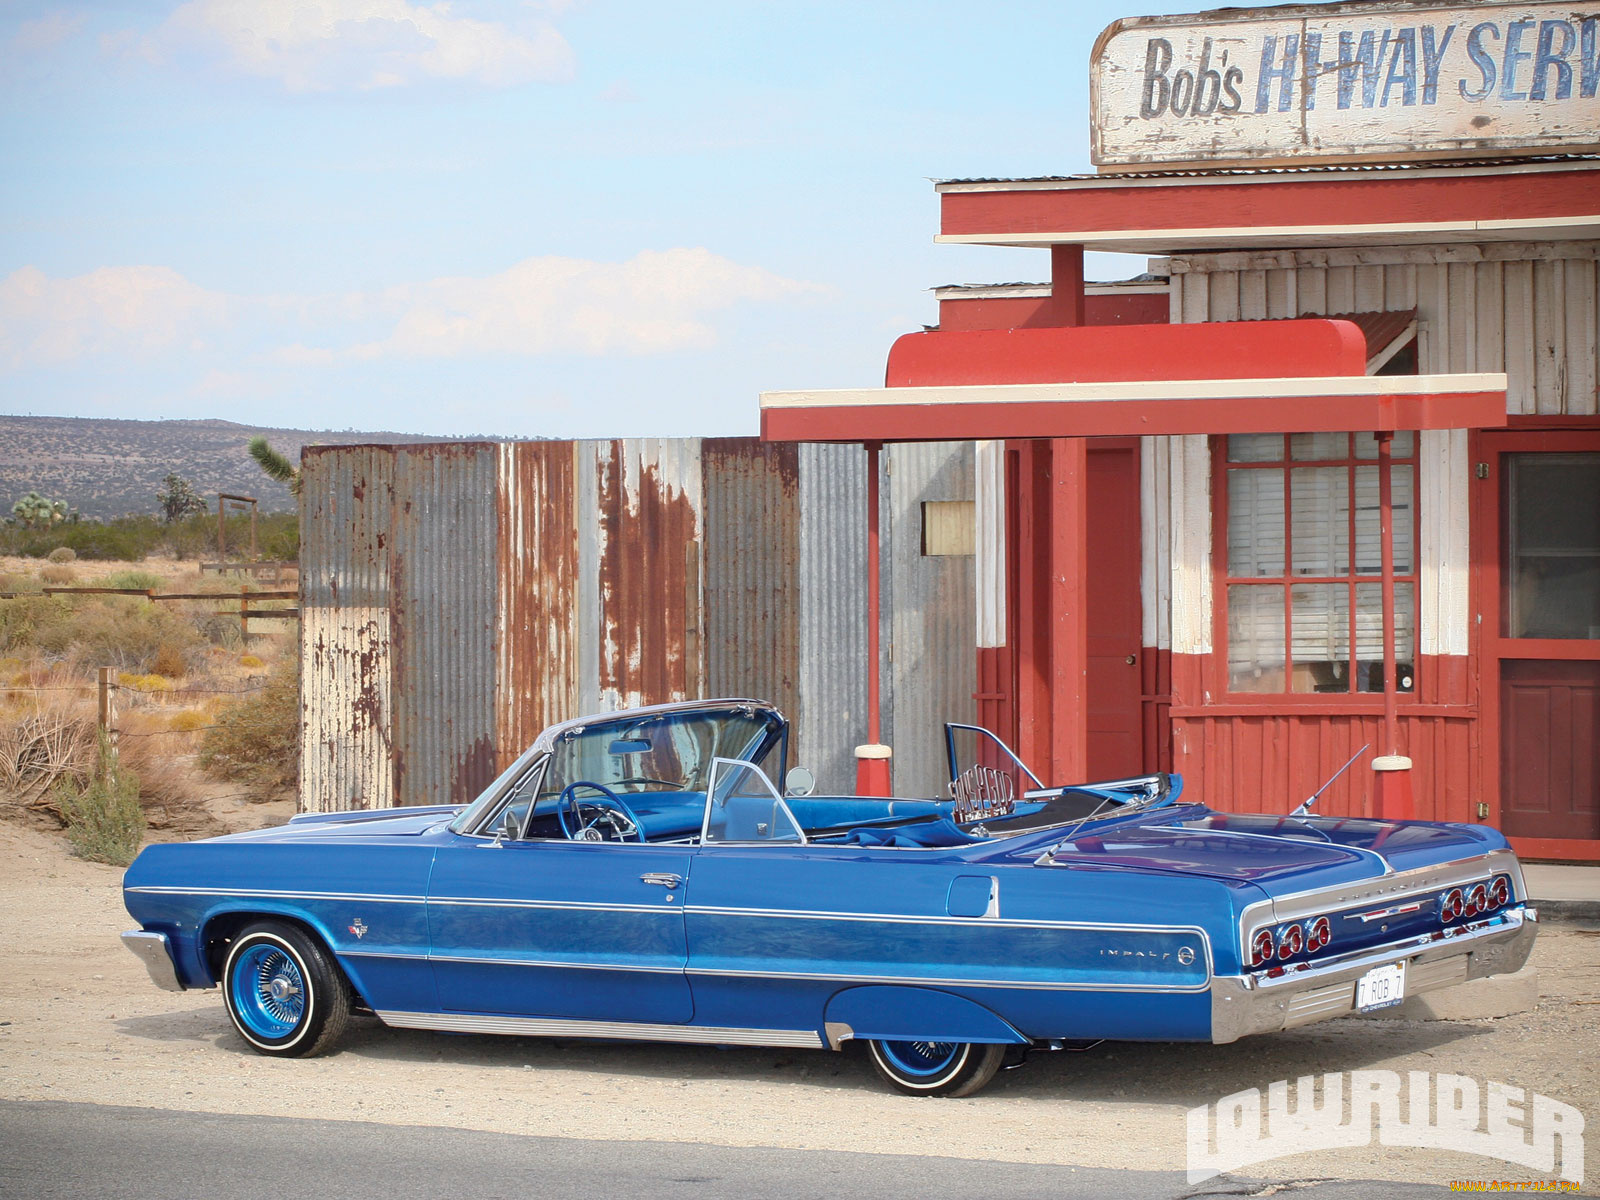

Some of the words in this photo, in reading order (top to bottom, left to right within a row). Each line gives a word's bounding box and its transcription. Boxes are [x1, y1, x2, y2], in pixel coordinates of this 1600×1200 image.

[1139, 36, 1244, 120] Bob's
[1254, 25, 1457, 114] HI-WAY
[1371, 978, 1390, 1002] ROB
